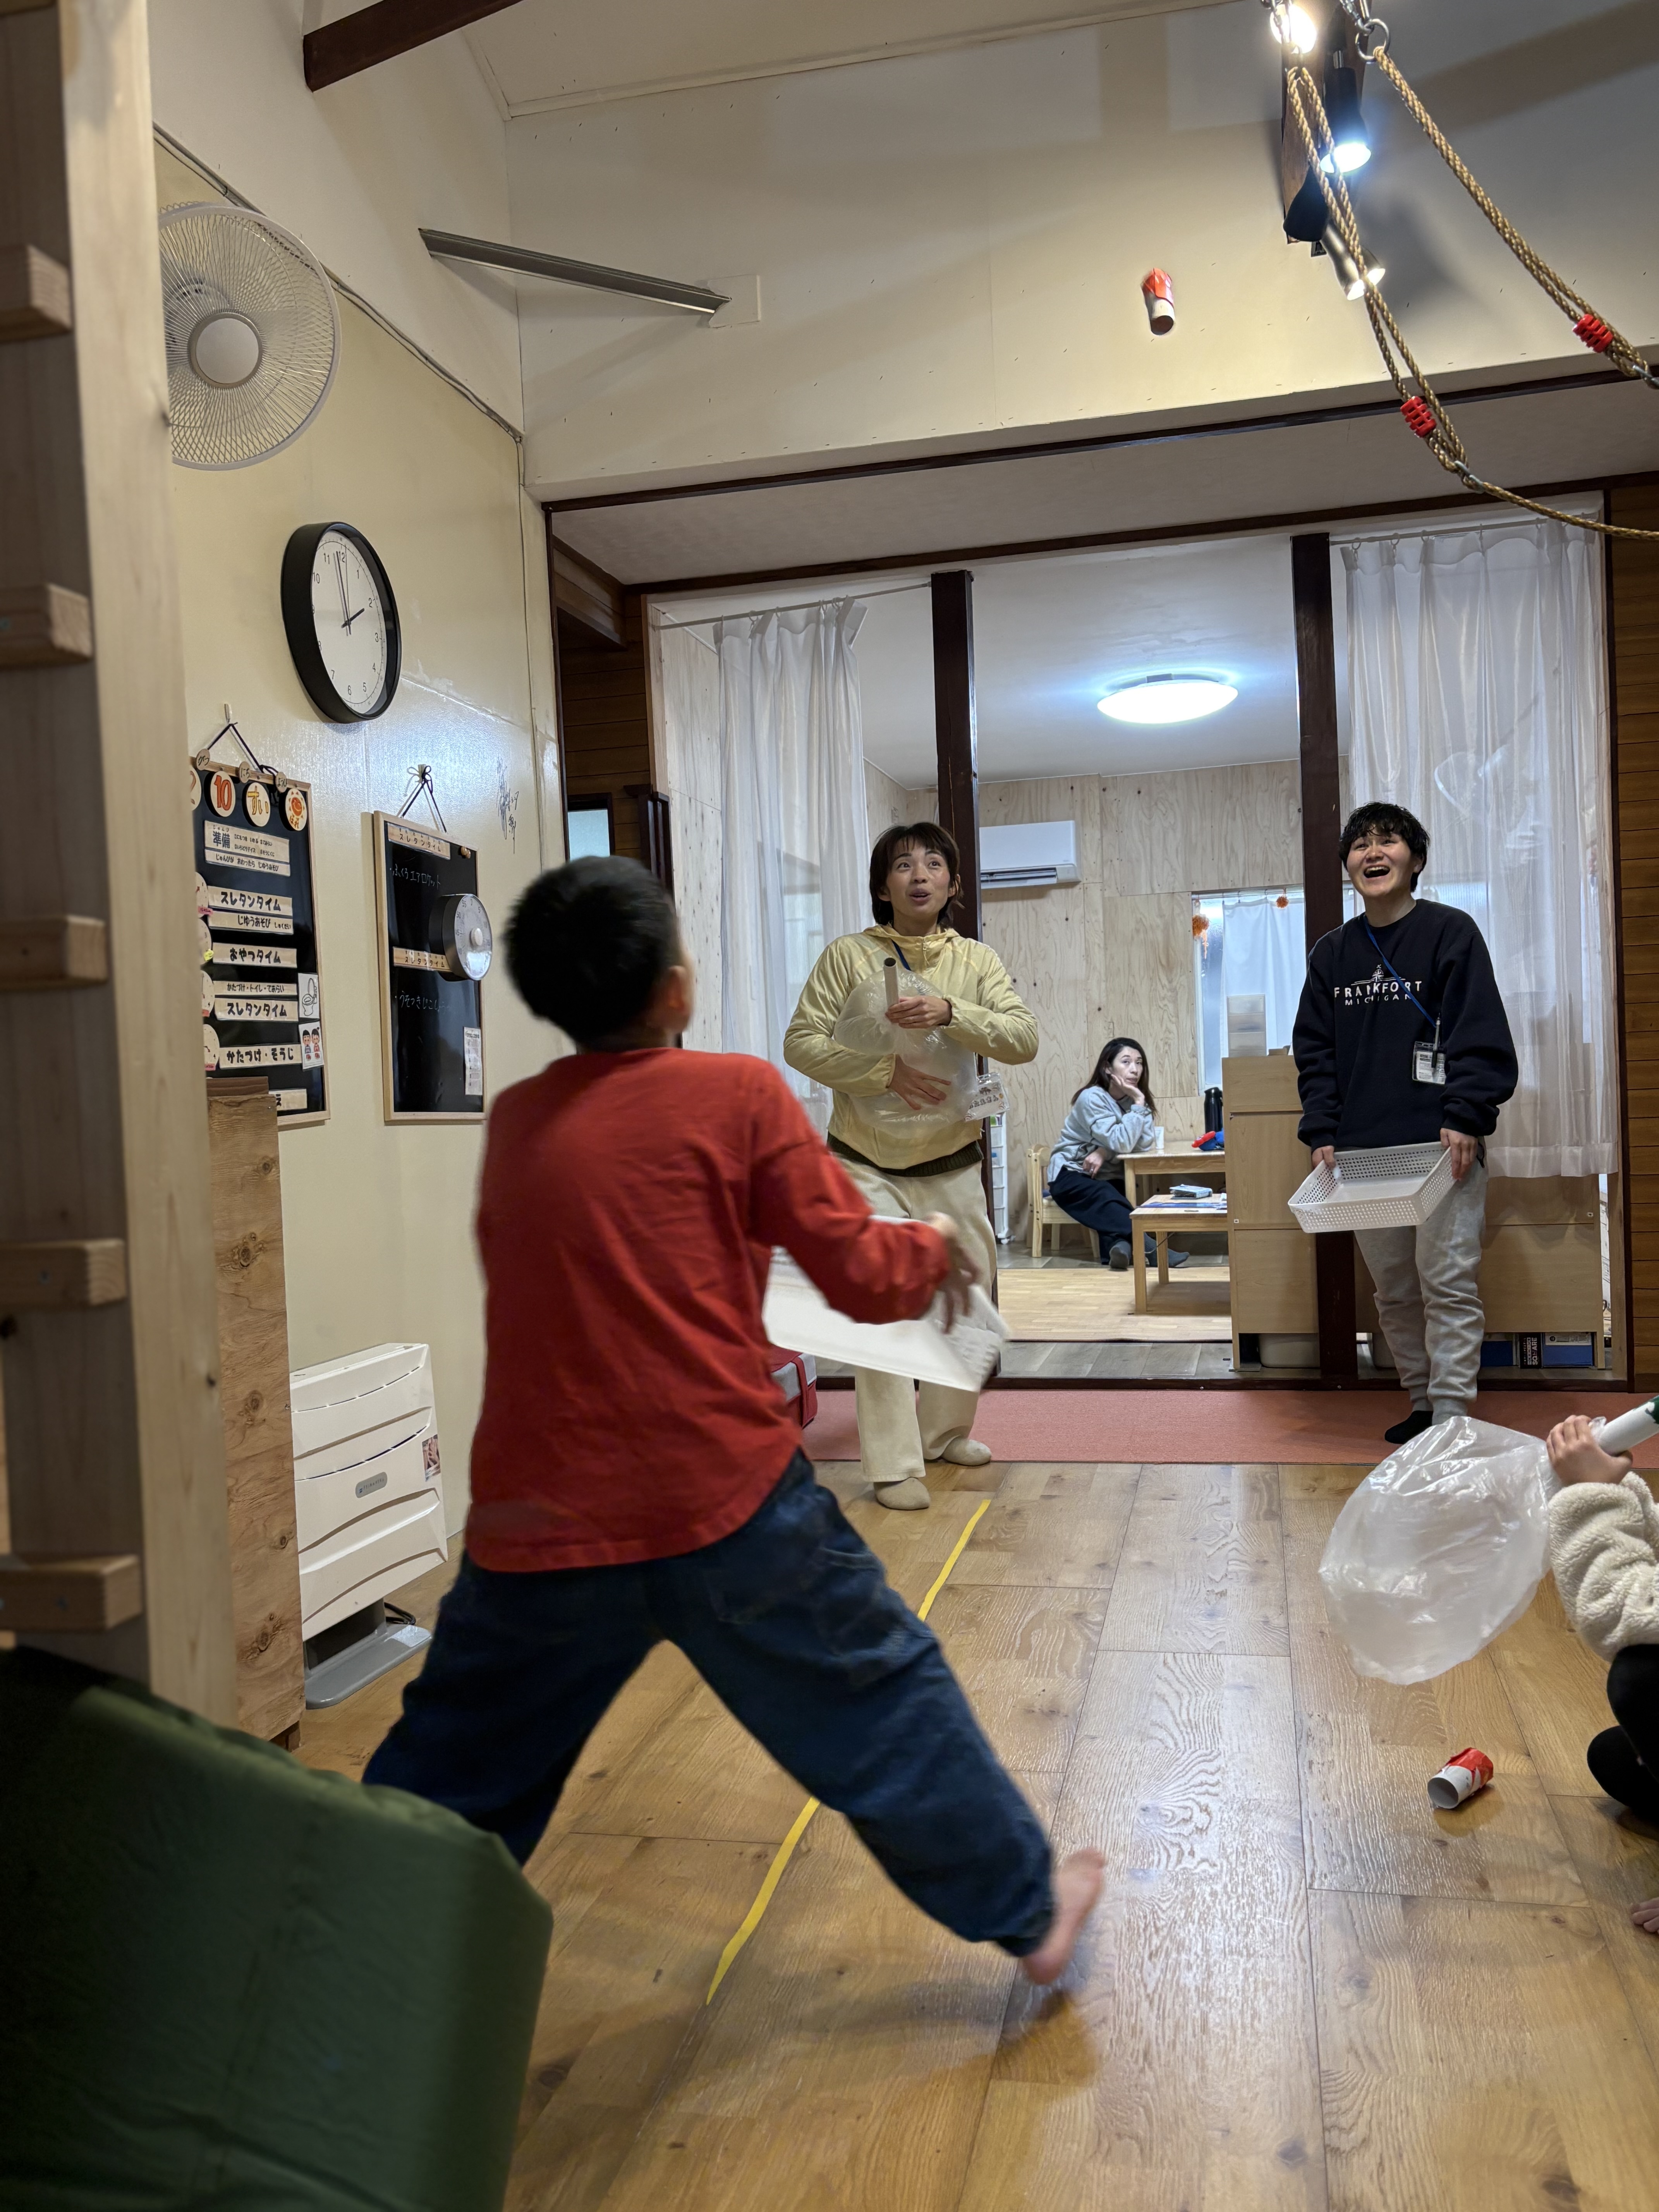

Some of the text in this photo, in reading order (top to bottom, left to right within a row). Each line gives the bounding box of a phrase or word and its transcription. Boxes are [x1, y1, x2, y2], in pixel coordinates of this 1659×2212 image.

[323, 553, 330, 565] 11
[338, 551, 345, 563] 12
[313, 572, 320, 584] 10
[357, 569, 359, 579] 1
[368, 598, 373, 608] 2
[375, 632, 379, 642] 3
[372, 663, 376, 672] 4
[331, 670, 335, 680] 7
[348, 685, 352, 695] 6
[363, 682, 367, 692] 5
[214, 775, 232, 811] 10
[247, 785, 269, 815] すい
[213, 831, 230, 848] 準備
[400, 834, 441, 852] スレタンタイム
[221, 891, 281, 911] スレタンタイム
[230, 948, 281, 963] おやつタイム
[405, 957, 445, 967] スレタンタイム
[227, 1002, 287, 1017] スレタンタイム
